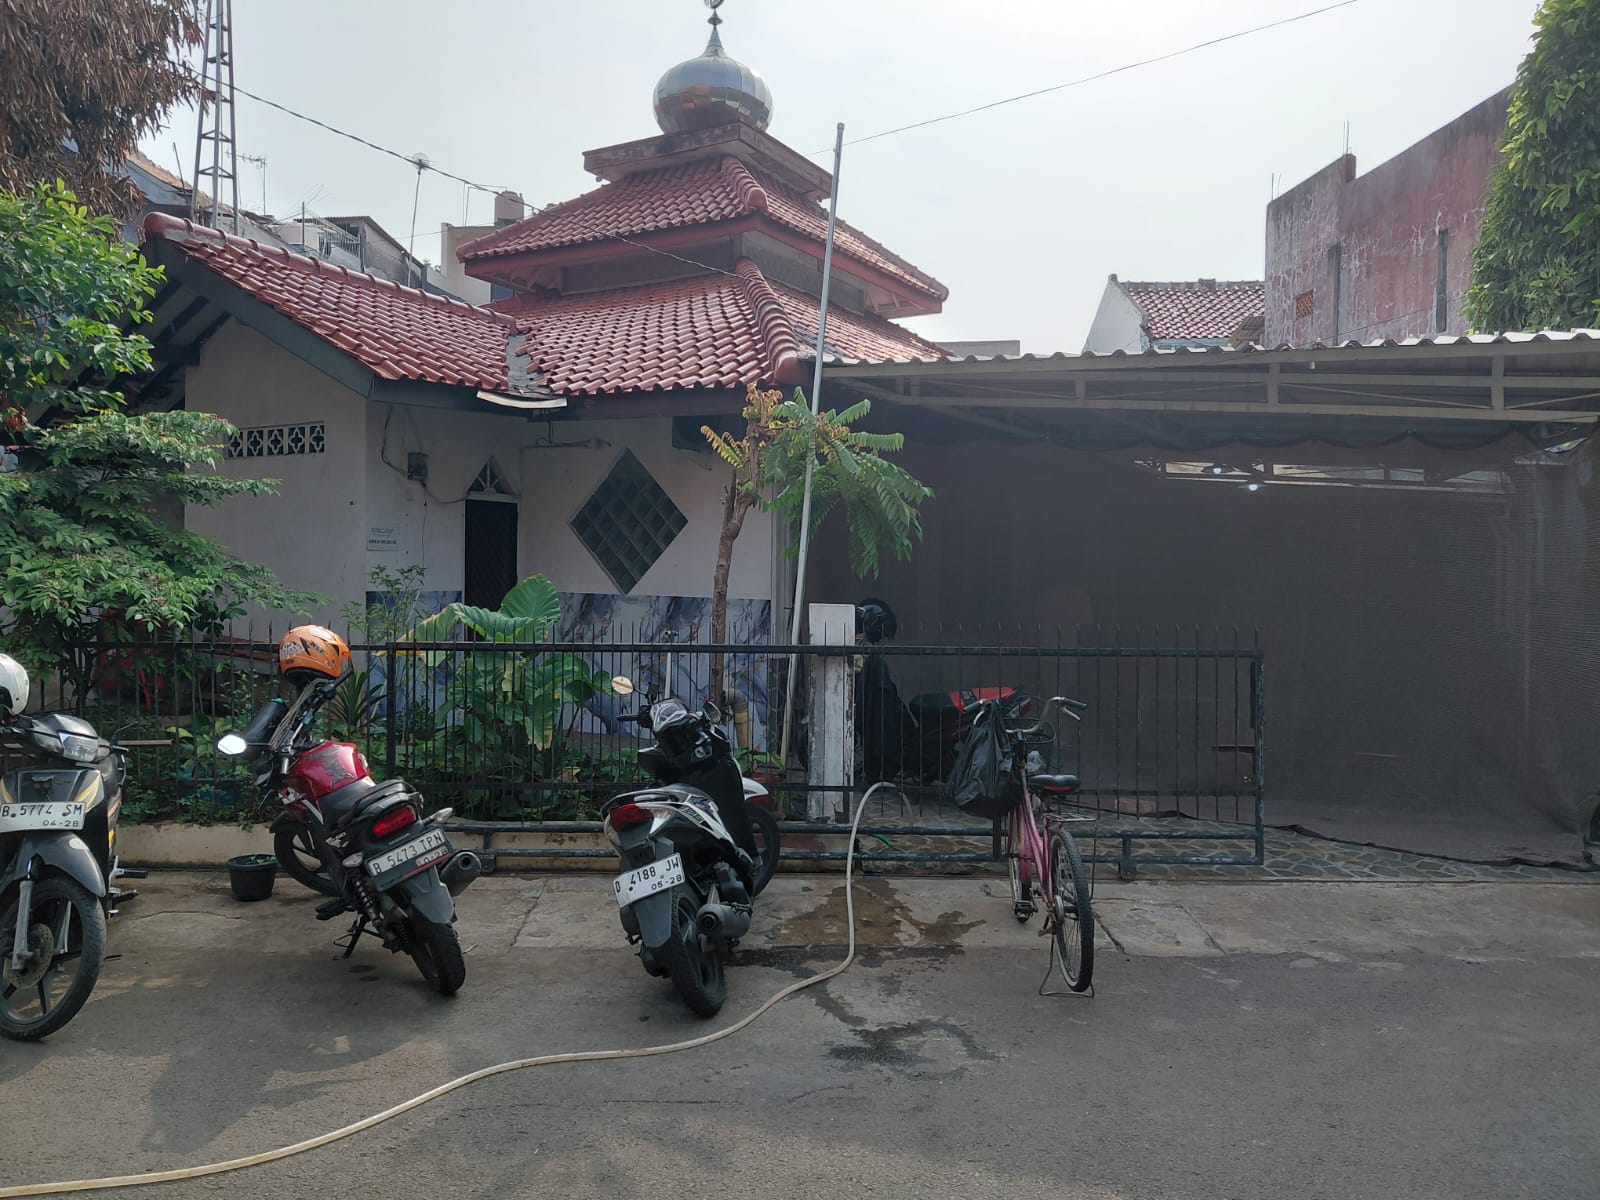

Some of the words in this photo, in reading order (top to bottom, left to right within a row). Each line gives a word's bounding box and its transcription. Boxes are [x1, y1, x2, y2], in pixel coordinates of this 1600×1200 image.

[373, 863, 382, 874] B
[387, 845, 418, 867] 5473
[421, 832, 443, 850] TPN
[630, 866, 656, 885] 4188
[666, 858, 679, 871] JW
[651, 874, 682, 890] 05-28
